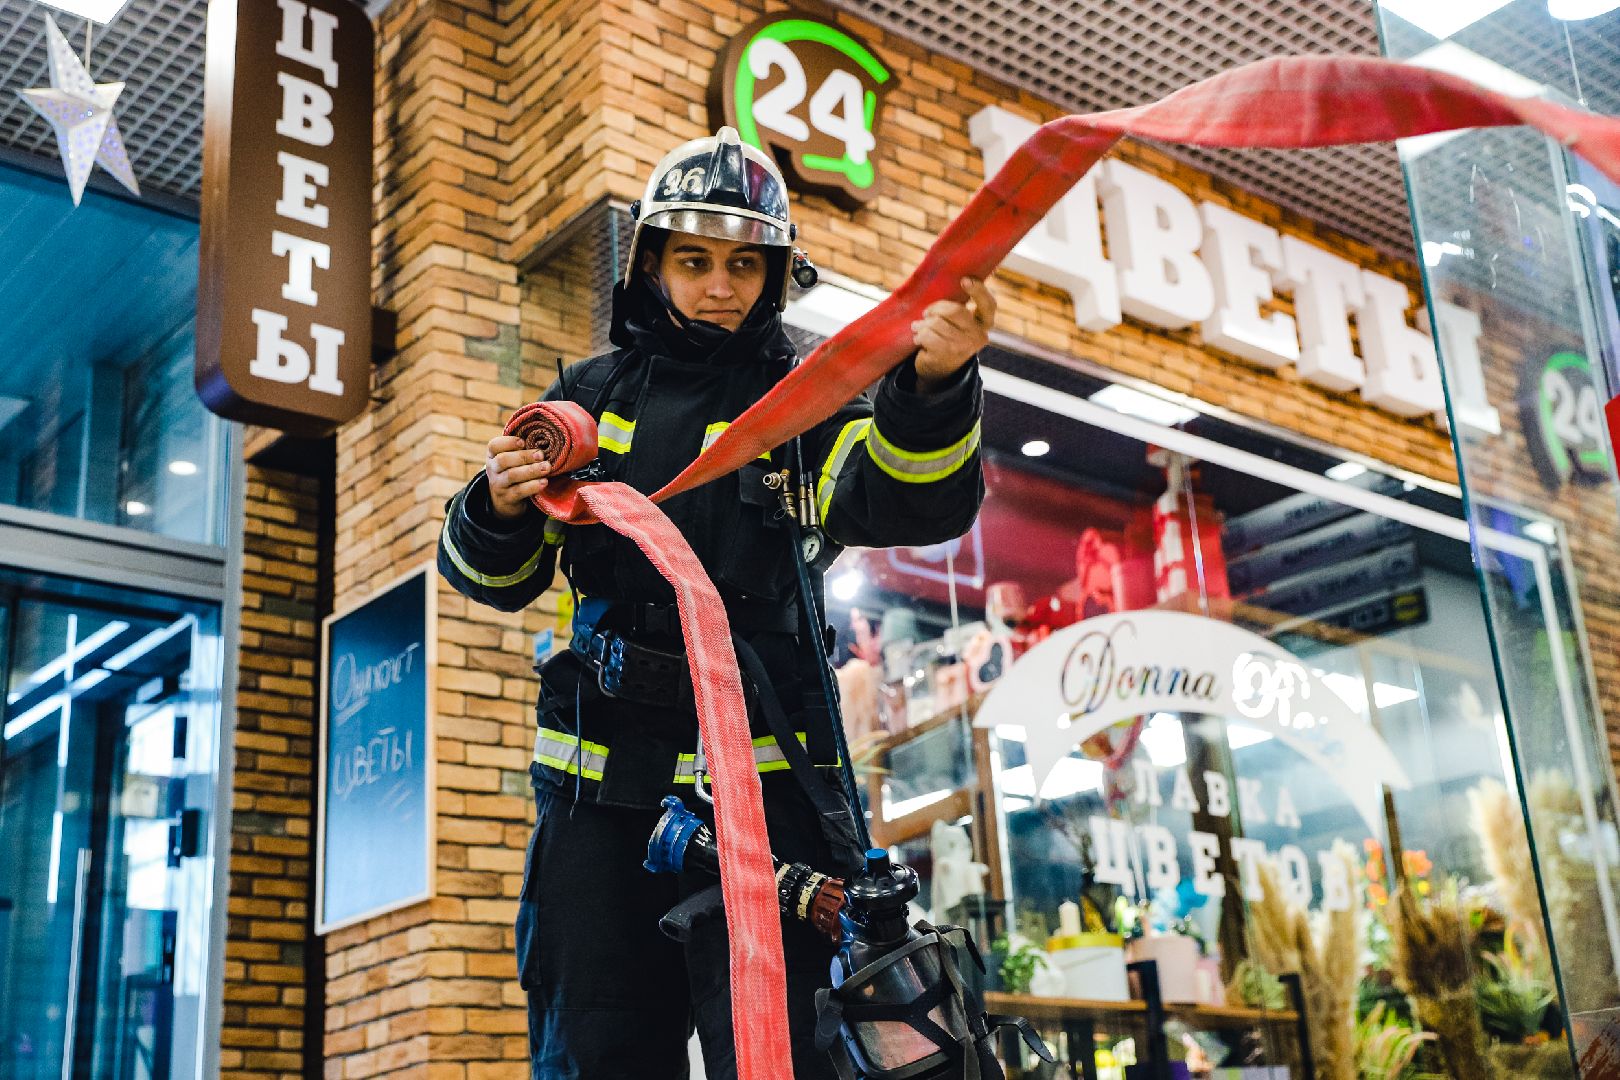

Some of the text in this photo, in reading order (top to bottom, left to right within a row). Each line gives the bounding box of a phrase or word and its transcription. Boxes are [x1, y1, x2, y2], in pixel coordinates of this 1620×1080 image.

[749, 38, 876, 164] 24
[250, 0, 345, 396] ЦВЕТЫ
[663, 167, 706, 196] 96
[967, 104, 1502, 436] ЦВЕТЫ
[1060, 620, 1222, 721] Donna
[1132, 760, 1302, 829] ЛАВКА
[1089, 815, 1353, 912] ЦВЕТОВ
